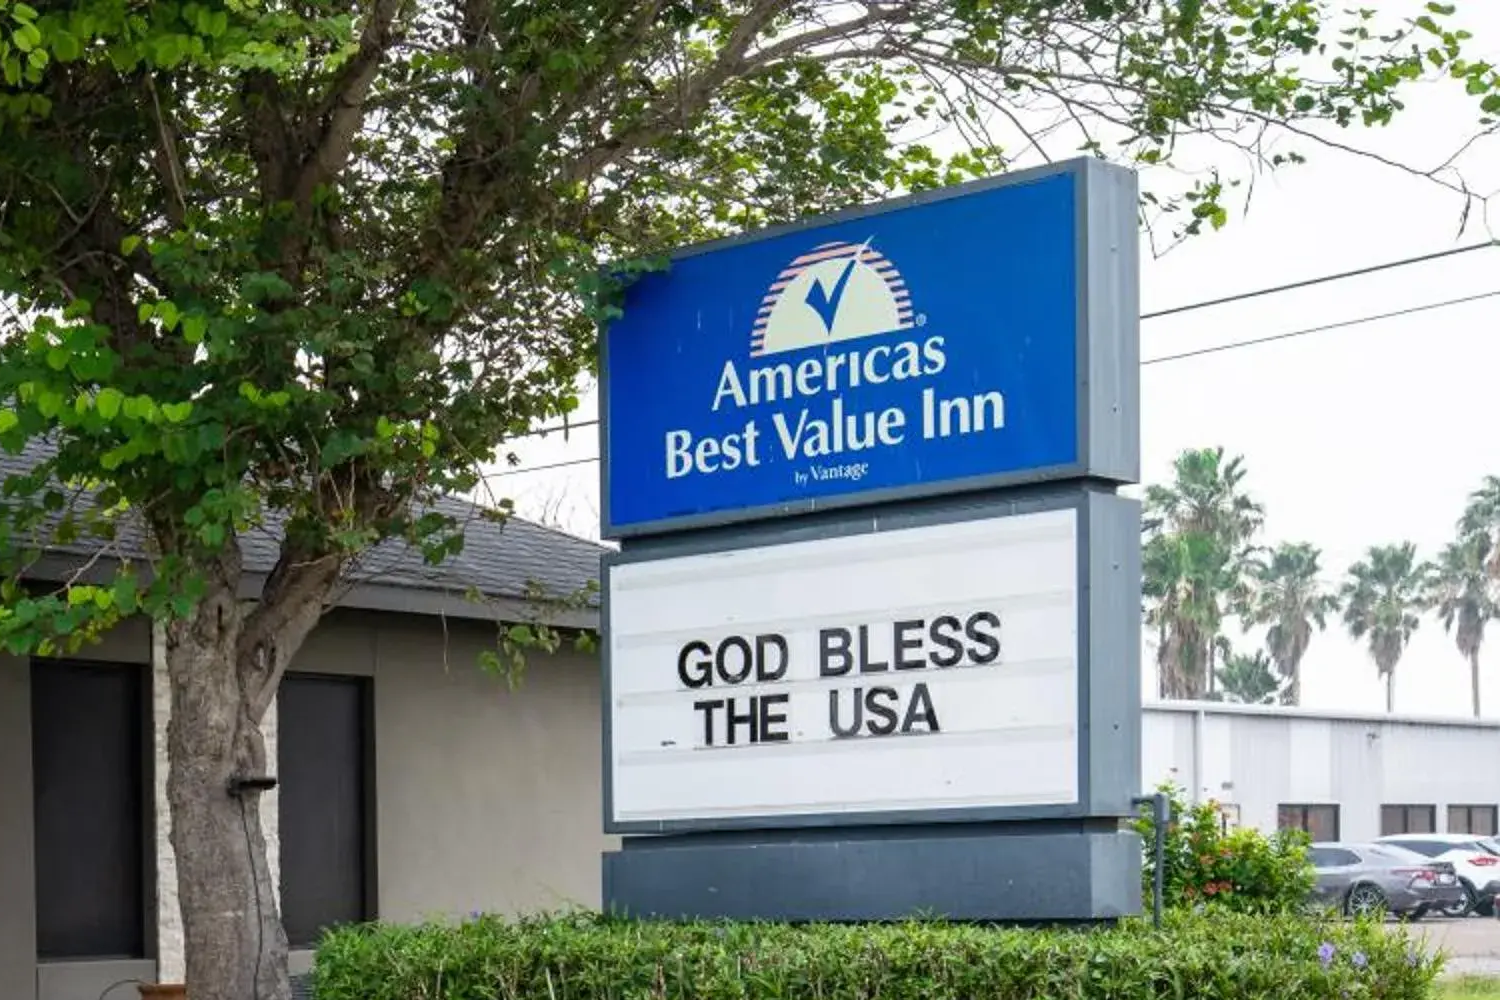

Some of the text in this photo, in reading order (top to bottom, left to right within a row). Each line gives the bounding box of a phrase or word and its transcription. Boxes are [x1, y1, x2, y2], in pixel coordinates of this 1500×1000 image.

[711, 335, 947, 412] Americas
[665, 386, 1006, 480] Best Value Inn
[794, 462, 869, 488] by Vantage
[677, 611, 1002, 689] GOD BLESS
[693, 683, 941, 747] THE USA
